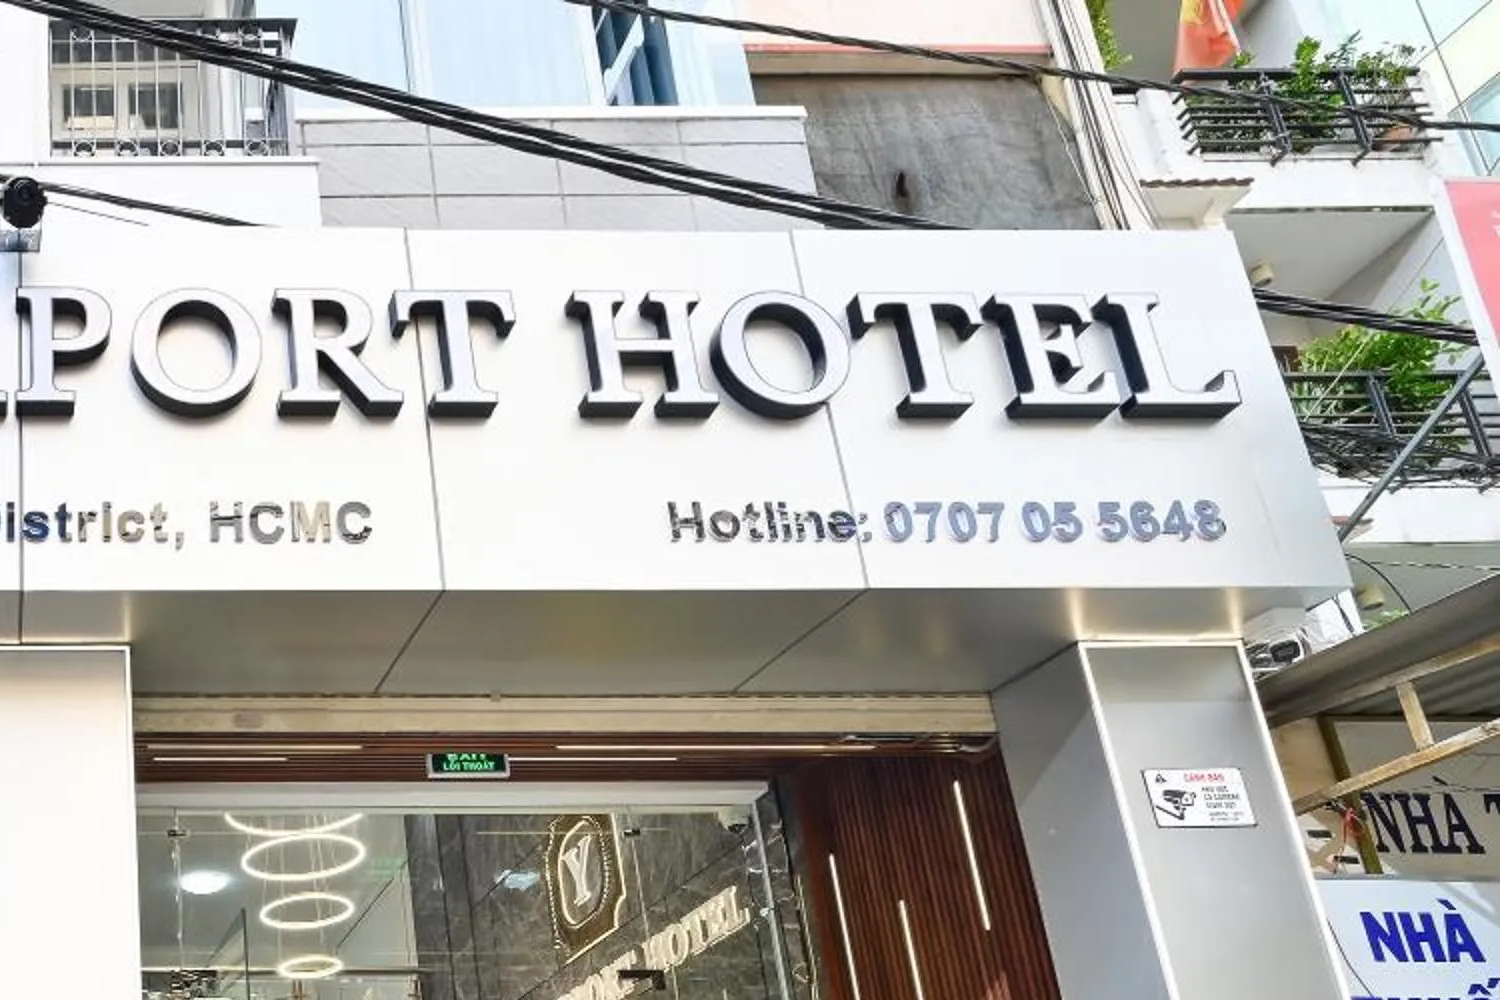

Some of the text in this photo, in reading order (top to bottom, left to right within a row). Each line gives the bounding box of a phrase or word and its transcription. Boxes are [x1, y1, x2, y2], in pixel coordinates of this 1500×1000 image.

[565, 290, 1243, 419] HOTEL
[208, 502, 375, 545] HCMC
[667, 499, 1228, 544] Hotline: 0707 05 5648
[1360, 774, 1487, 855] NHÀ
[1359, 898, 1487, 962] NHÀ
